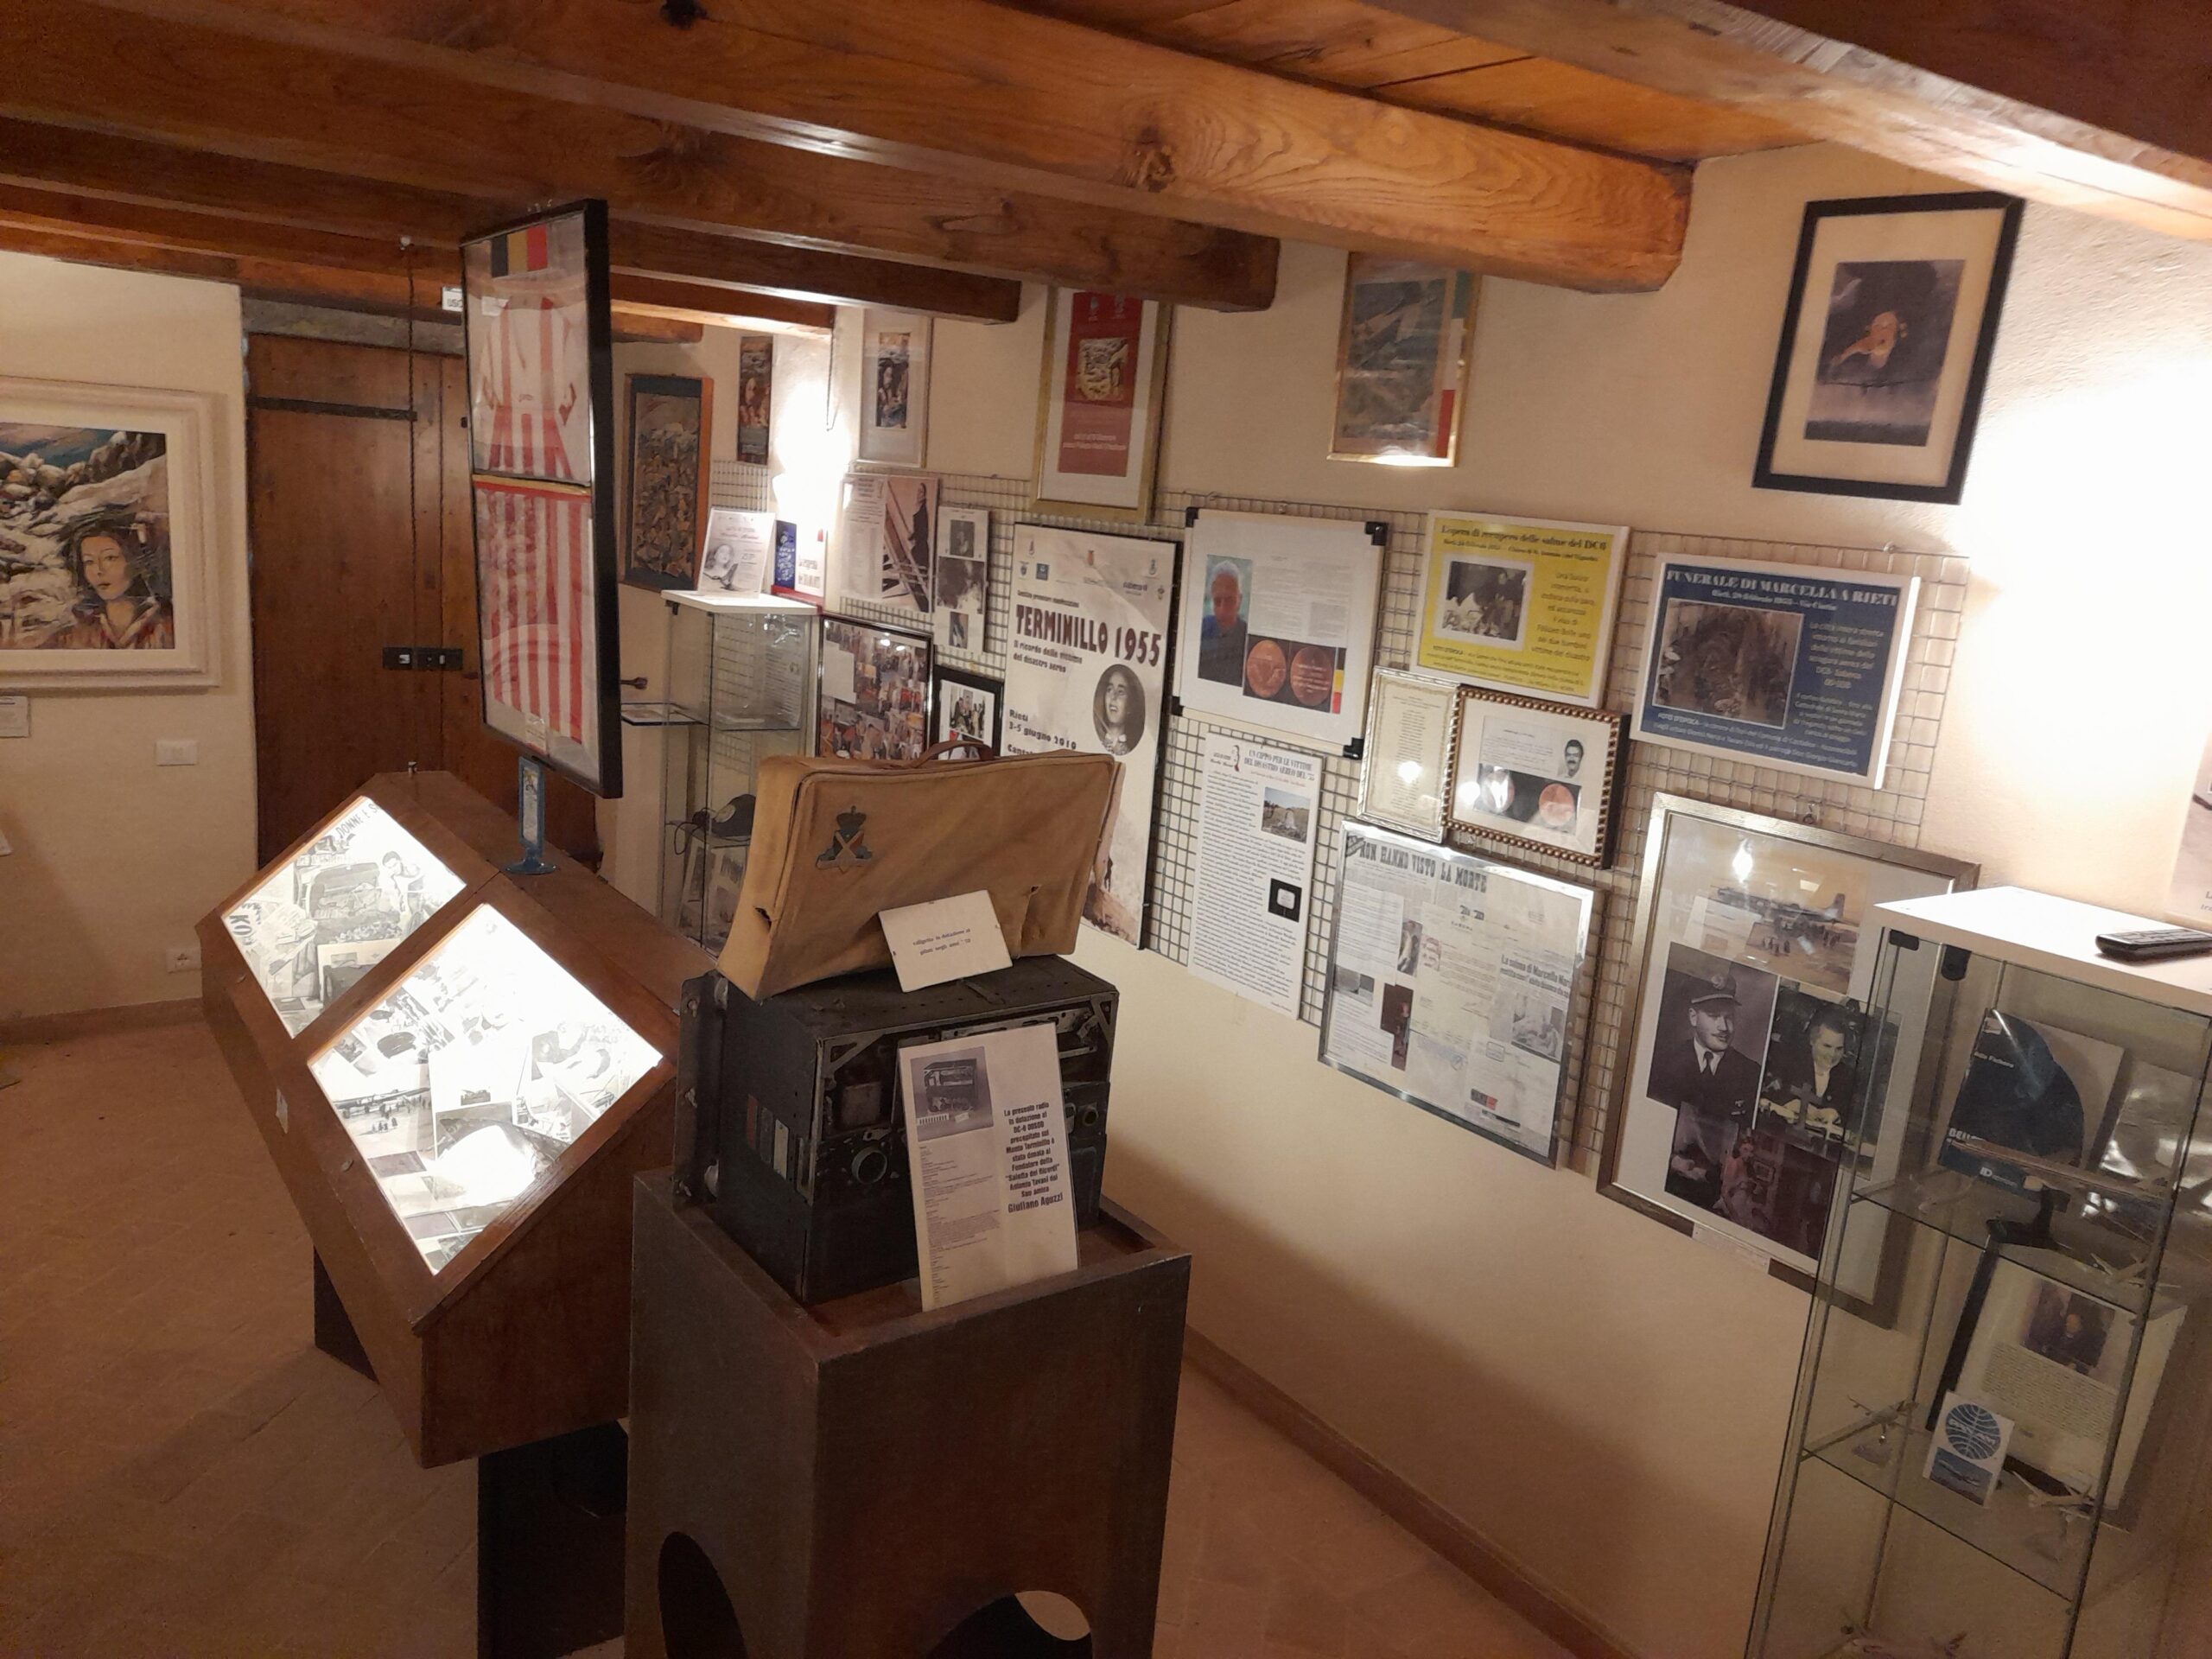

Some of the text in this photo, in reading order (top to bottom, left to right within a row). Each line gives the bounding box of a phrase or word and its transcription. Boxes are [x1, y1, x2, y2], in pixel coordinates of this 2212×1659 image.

[1666, 570, 1898, 607] FUNERALE DI MARCELLA A RIETI
[1016, 604, 1162, 667] TERMINILLO 1955
[1009, 709, 1028, 721] Rieti
[1053, 735, 1077, 750] 2010
[1360, 841, 1487, 893] NON HANNO VISTO LA MORTE
[1012, 1104, 1035, 1116] presente
[1035, 1102, 1050, 1110] radio
[1015, 1113, 1041, 1124] dotazione
[1006, 1145, 1024, 1154] Monte
[1025, 1139, 1051, 1150] Terminillo
[1007, 1192, 1064, 1214] Giuliano Aguzzi
